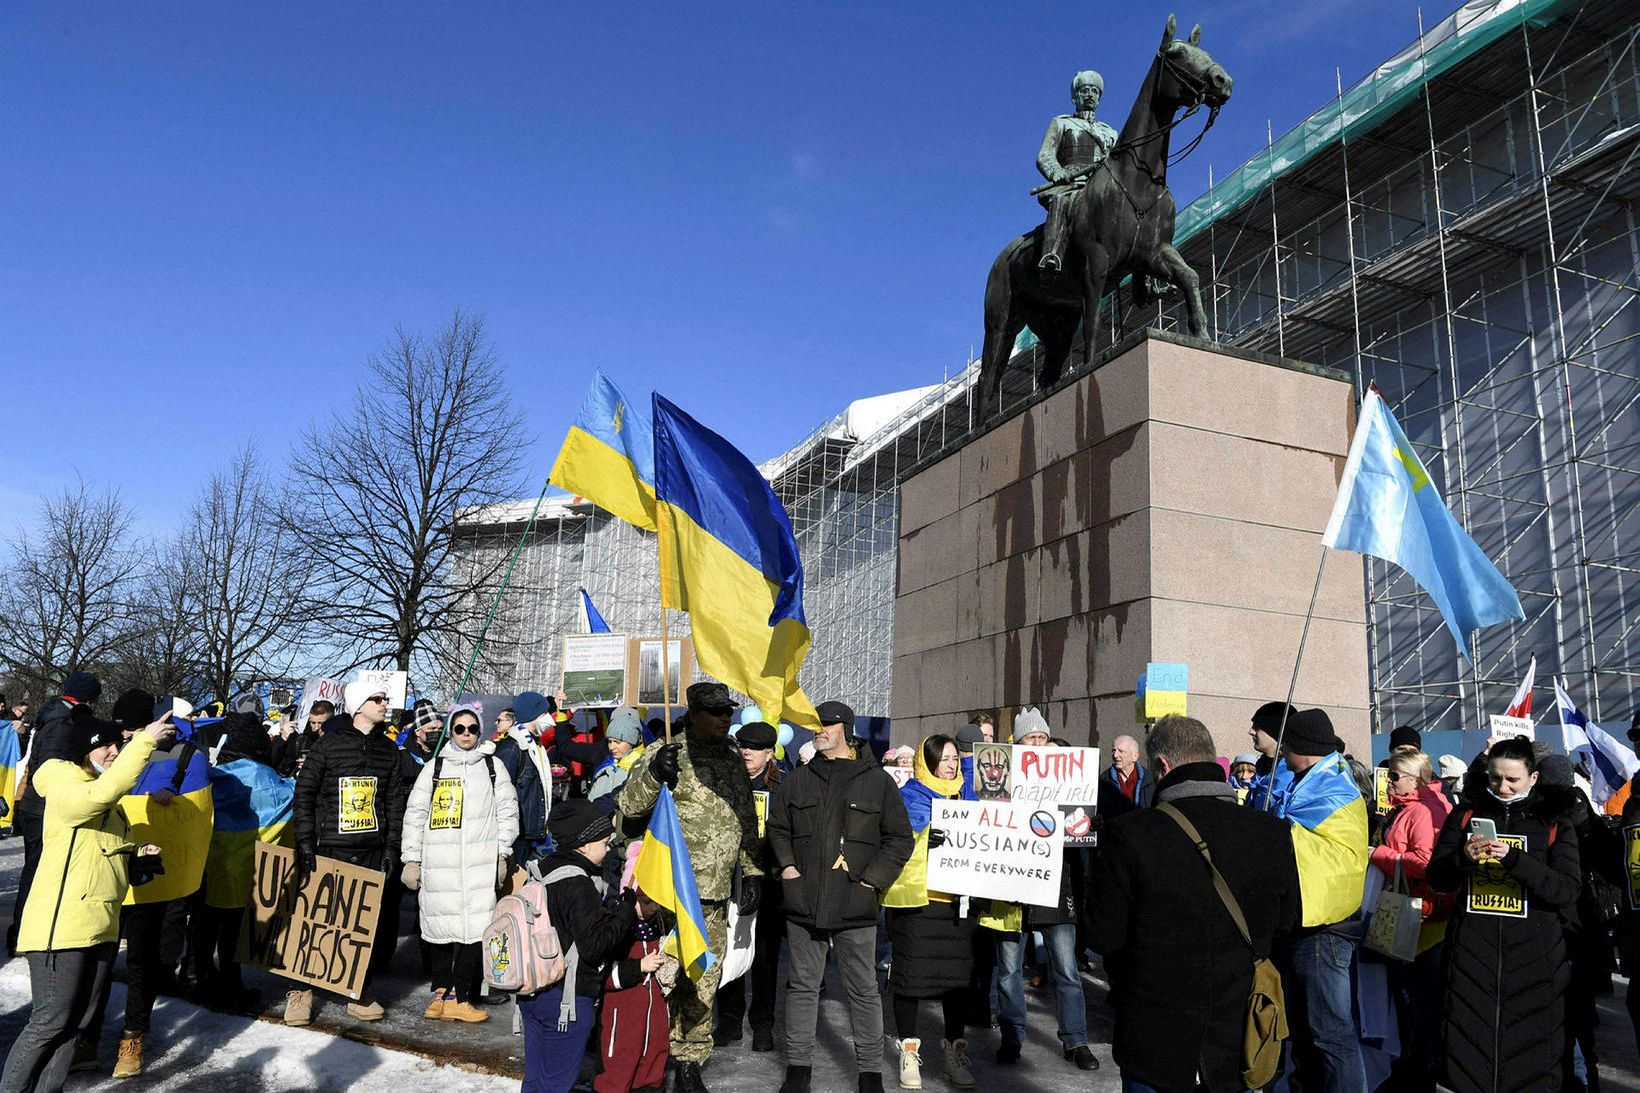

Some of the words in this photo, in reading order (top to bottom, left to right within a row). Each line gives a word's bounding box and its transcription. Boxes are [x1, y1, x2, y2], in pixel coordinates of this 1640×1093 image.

[1152, 668, 1183, 684] End
[318, 680, 345, 700] RUSS
[1494, 719, 1514, 728] Putin
[1021, 749, 1085, 781] PUTIN
[942, 809, 969, 819] BAN
[978, 807, 1019, 829] ALL
[1075, 835, 1097, 843] PUTIN
[940, 857, 969, 868] FROM
[974, 861, 1052, 880] EVERYWERE
